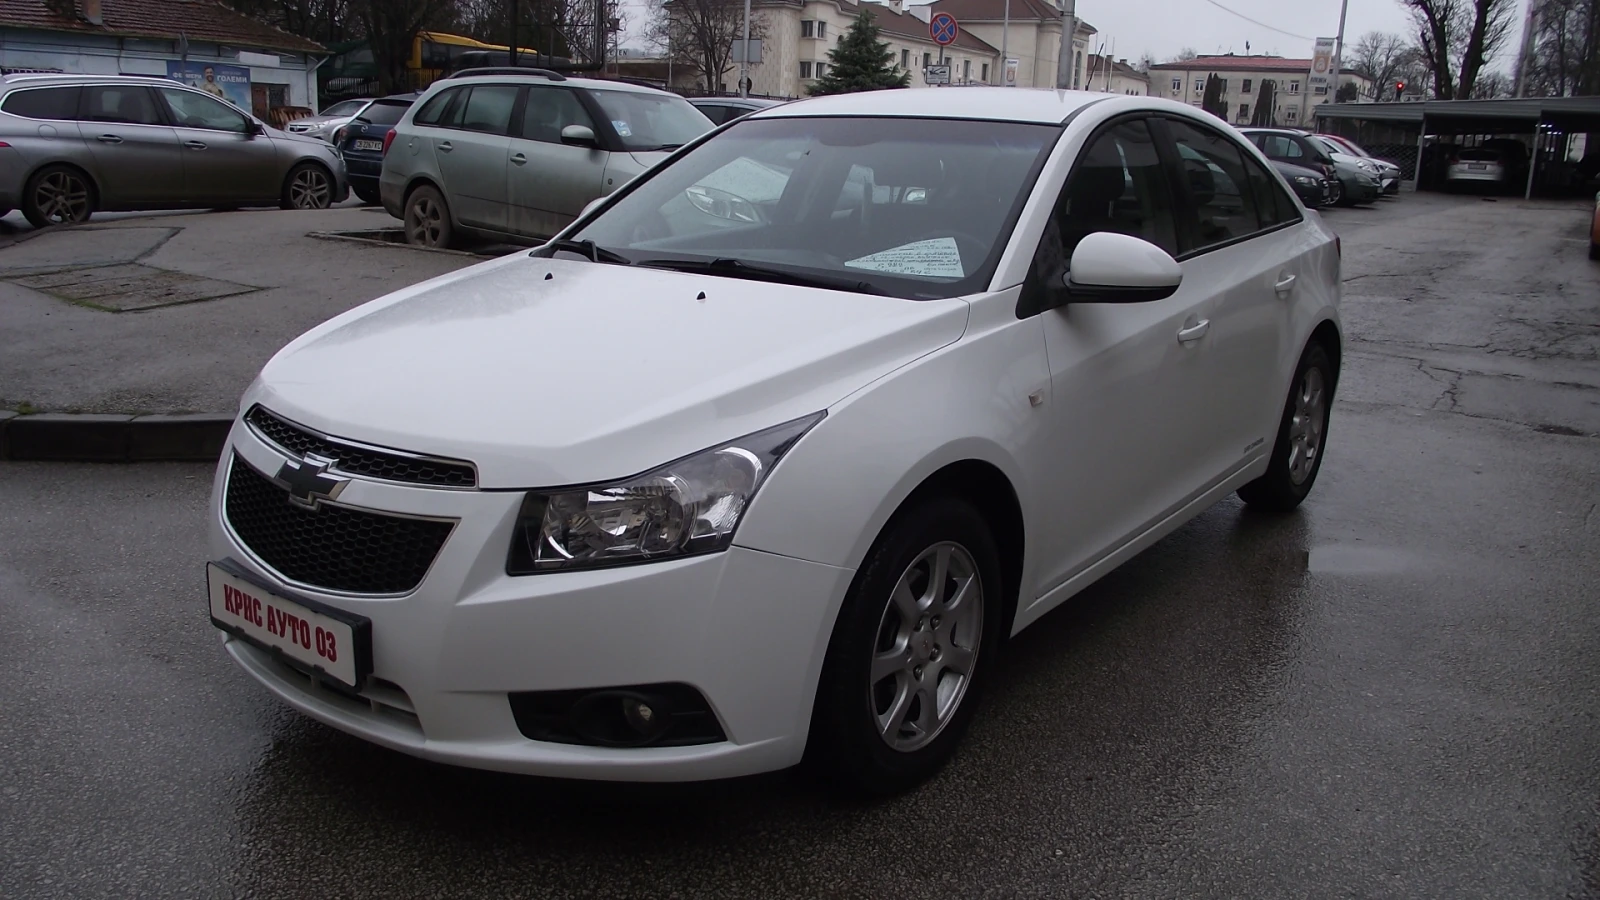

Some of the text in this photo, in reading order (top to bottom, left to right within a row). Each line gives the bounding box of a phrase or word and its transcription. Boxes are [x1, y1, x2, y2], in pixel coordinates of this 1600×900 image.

[217, 75, 247, 83] ГОЛЕМИ
[223, 583, 263, 627] КРИС
[267, 604, 311, 650] АУТО
